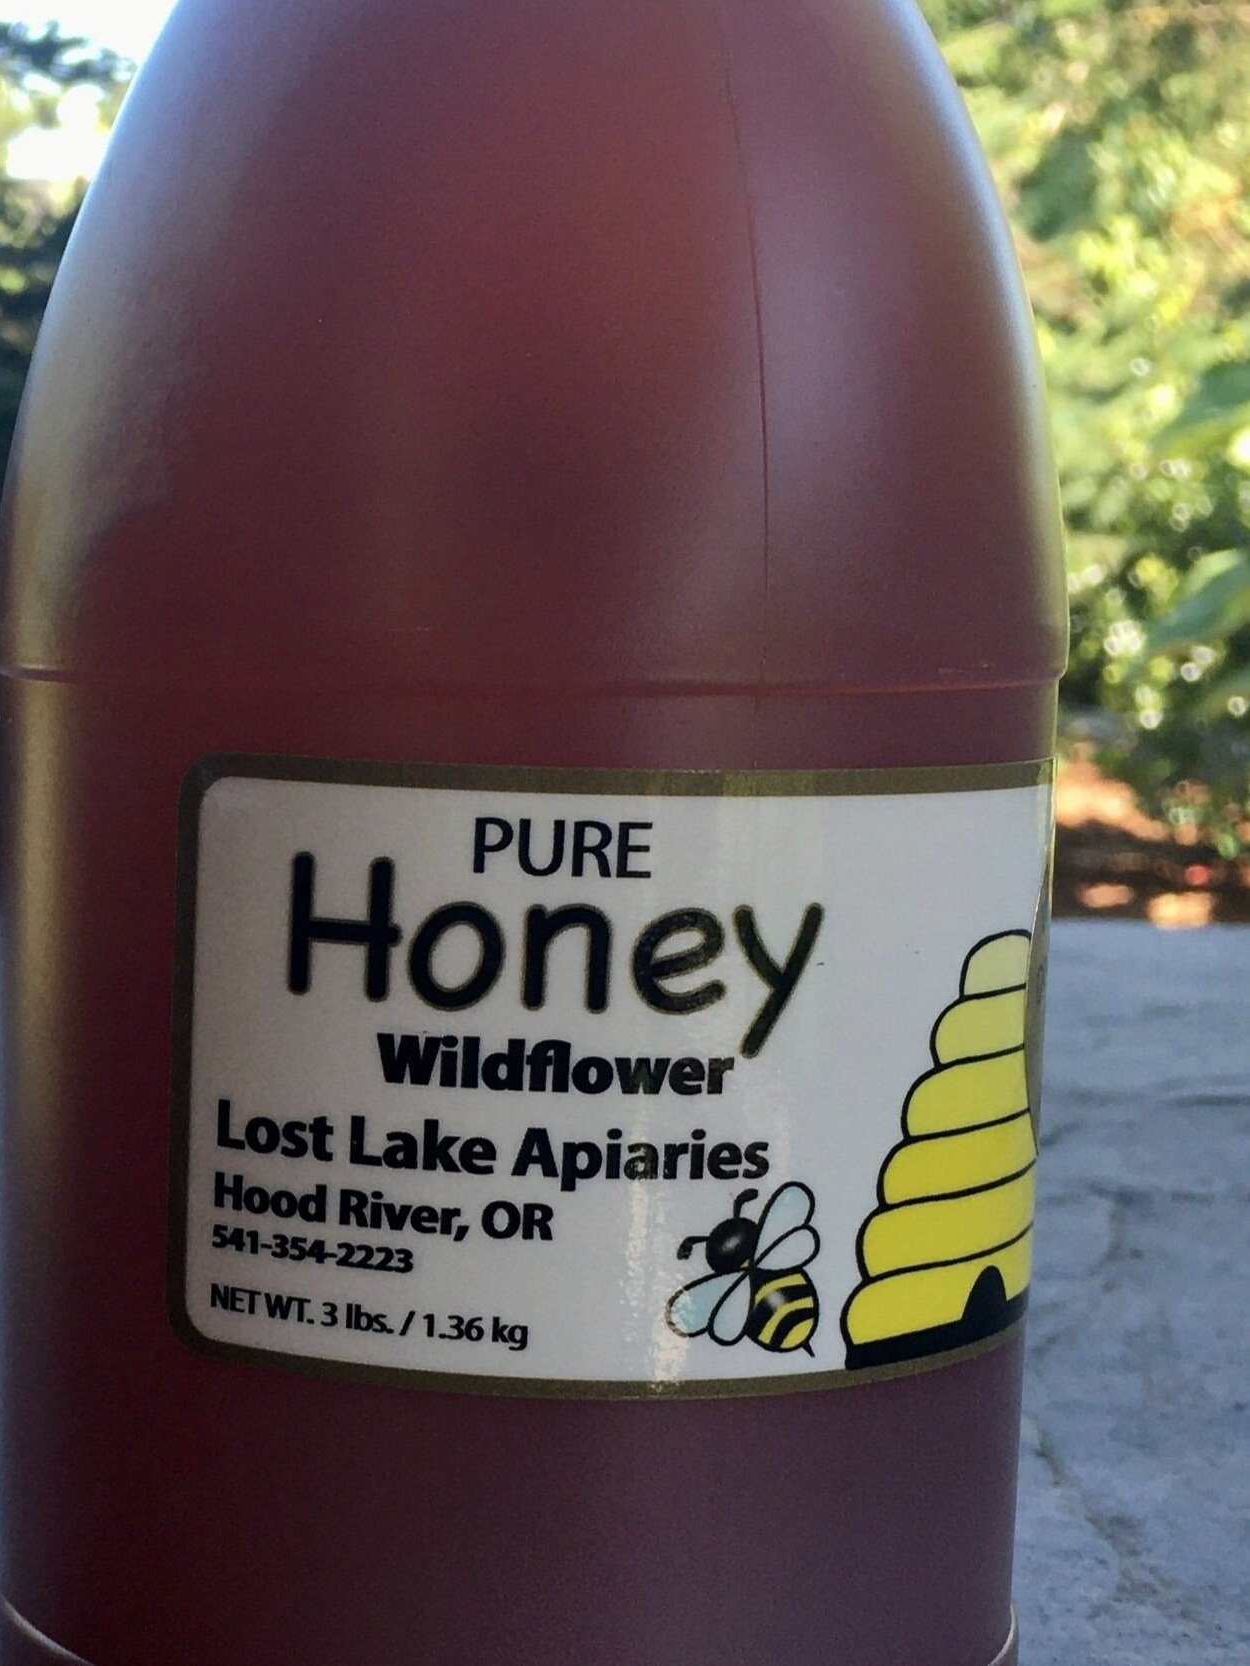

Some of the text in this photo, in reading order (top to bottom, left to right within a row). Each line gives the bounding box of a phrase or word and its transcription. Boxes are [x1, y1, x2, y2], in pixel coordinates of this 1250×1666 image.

[472, 816, 653, 879] PURE
[286, 850, 825, 1059] Honey
[376, 1032, 735, 1096] Wildflower
[215, 1099, 770, 1193] Lost Lake Apiaries
[213, 1172, 555, 1243] Hood River, OR
[210, 1224, 414, 1275] 541-354-2223
[209, 1283, 529, 1352] NET WT. 3 lbs. / 1.36 kg
